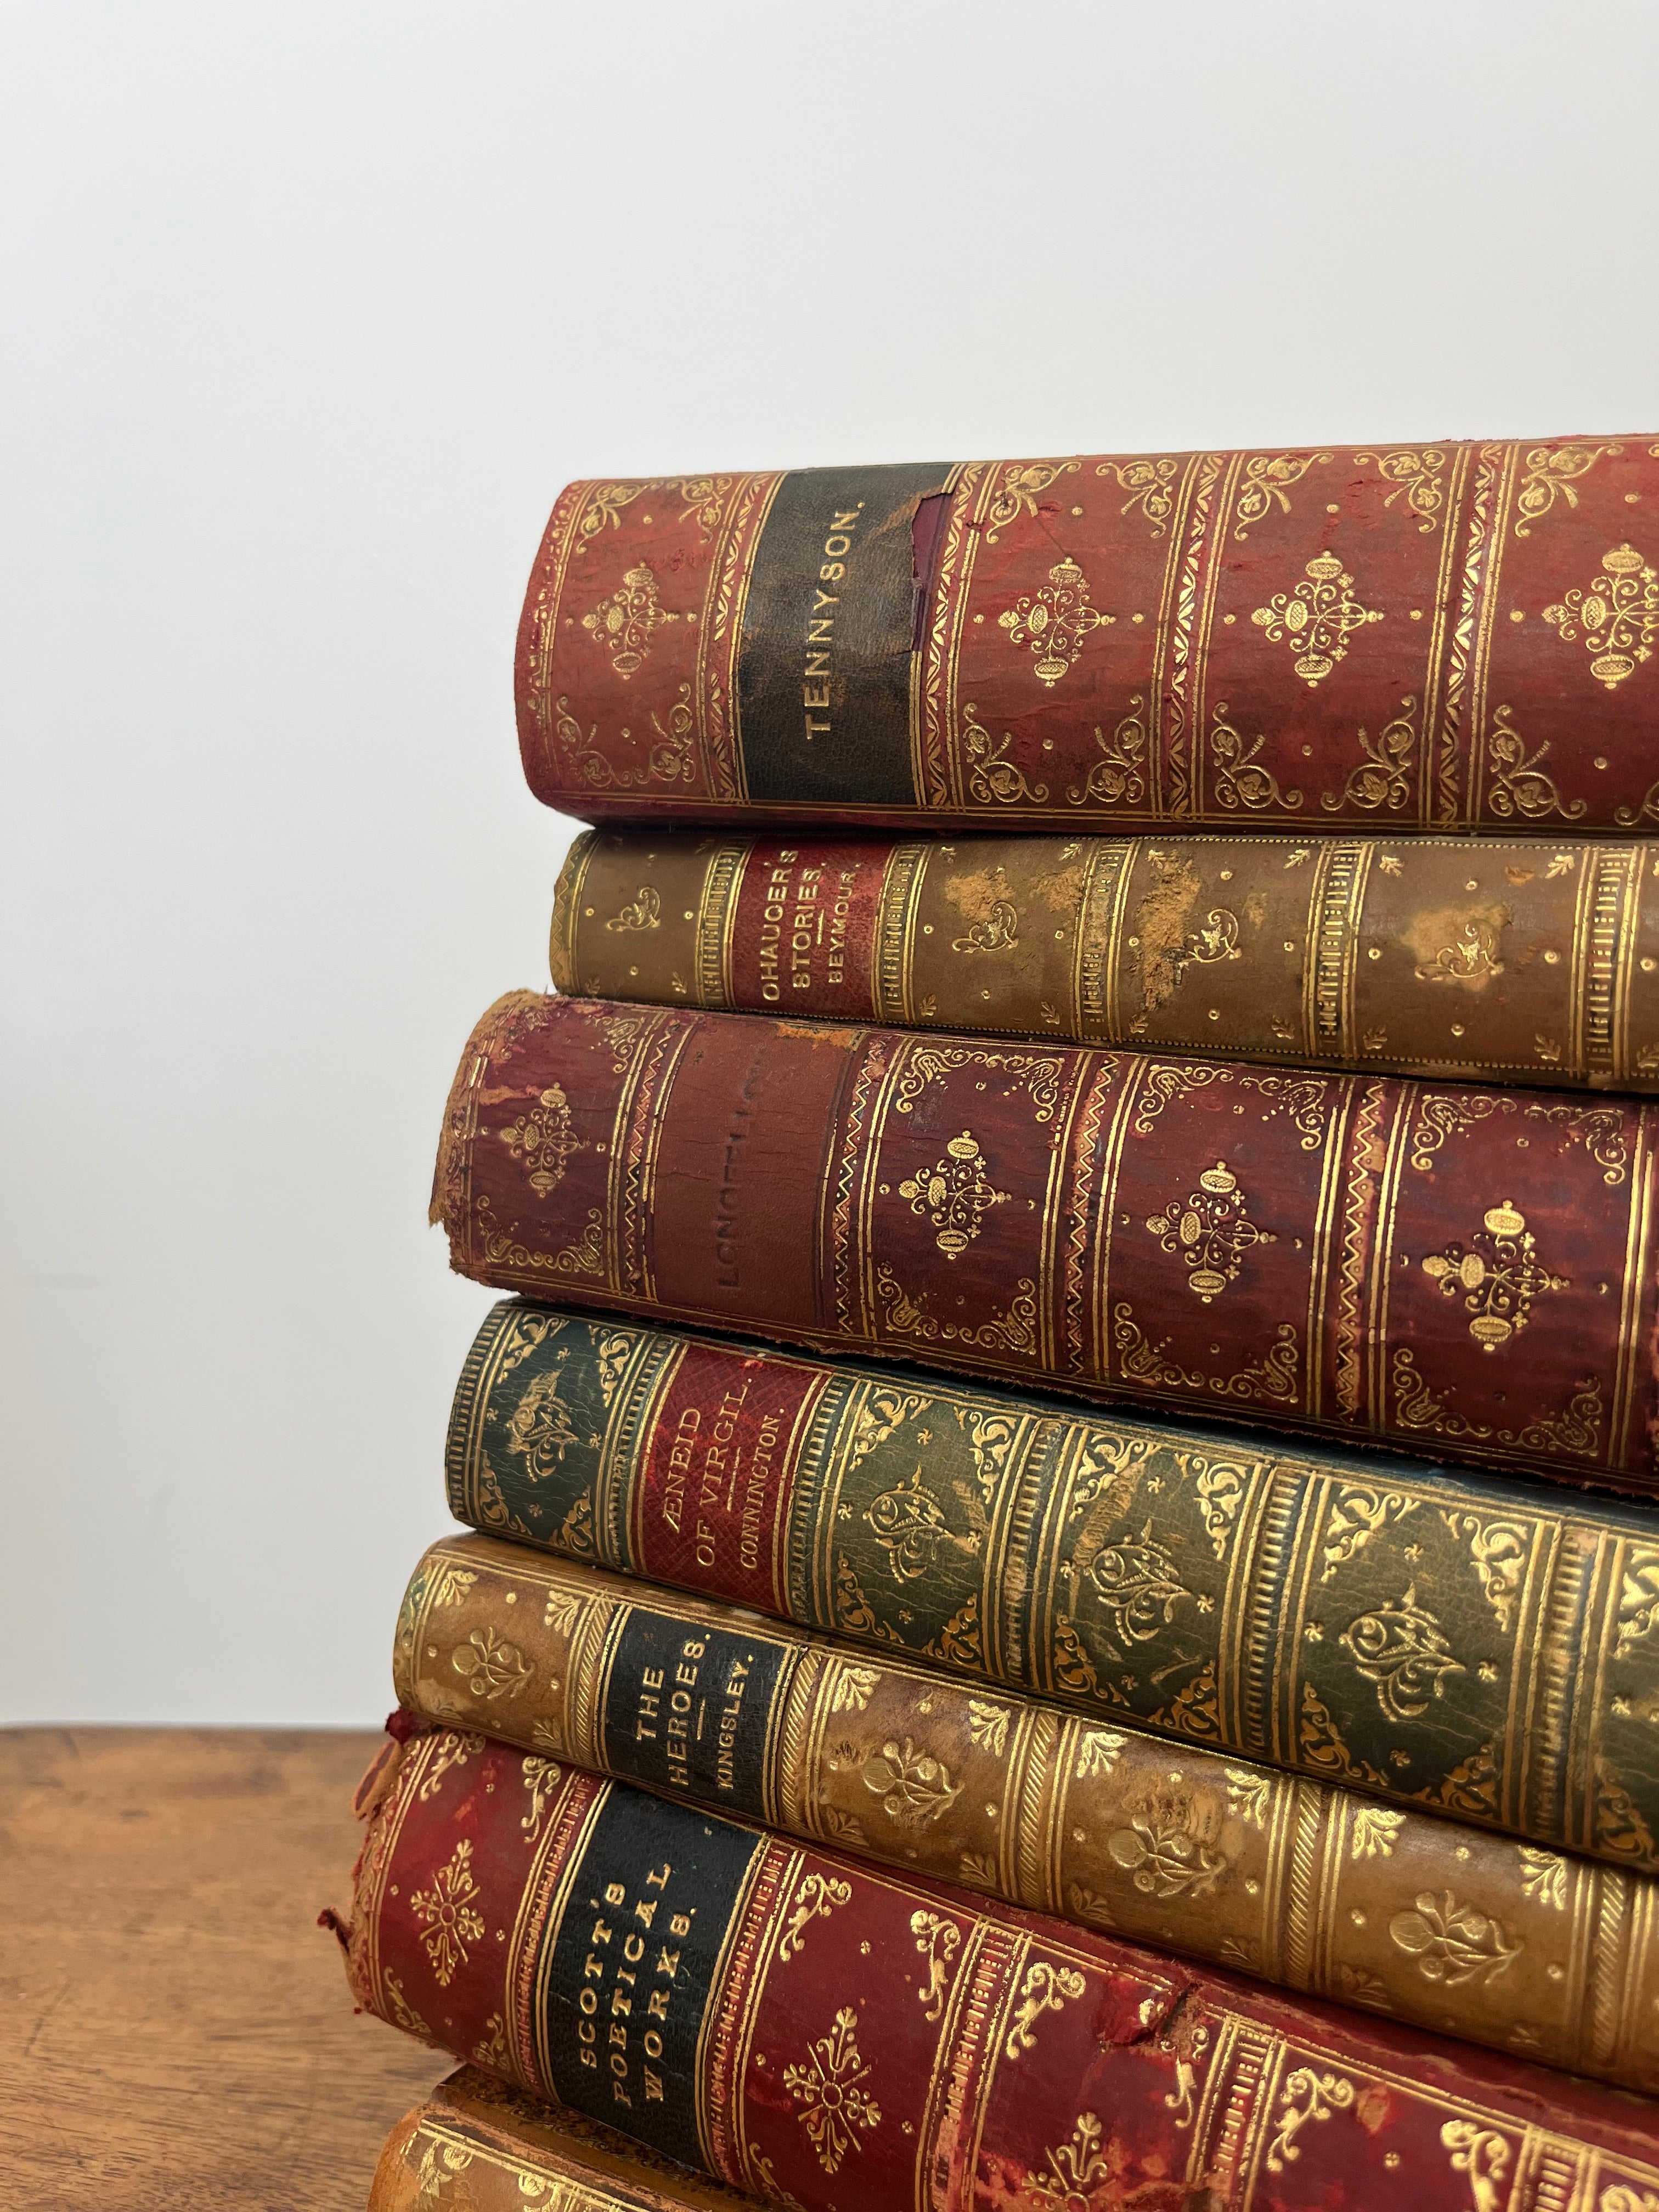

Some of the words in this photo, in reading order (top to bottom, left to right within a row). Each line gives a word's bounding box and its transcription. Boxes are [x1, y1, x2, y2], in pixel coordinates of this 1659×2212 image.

[804, 501, 865, 740] TENNYSON.
[760, 850, 799, 1001] CHAUCER'S
[792, 863, 827, 988] STORIES.
[828, 863, 861, 983] SEYMOUR.
[662, 1408, 701, 1533] ÆNEID
[699, 1378, 752, 1505] VIRGIL.
[740, 1408, 785, 1570] CONNINGTON.
[696, 1520, 715, 1566] OF
[635, 1666, 665, 1741] THE
[667, 1633, 712, 1786] HEROES.
[717, 1654, 754, 1790] KINGSLEY.
[578, 1882, 627, 2069] SCOTT'S
[609, 1863, 672, 2107] POETICAL
[644, 1906, 697, 2102] WORKS.
